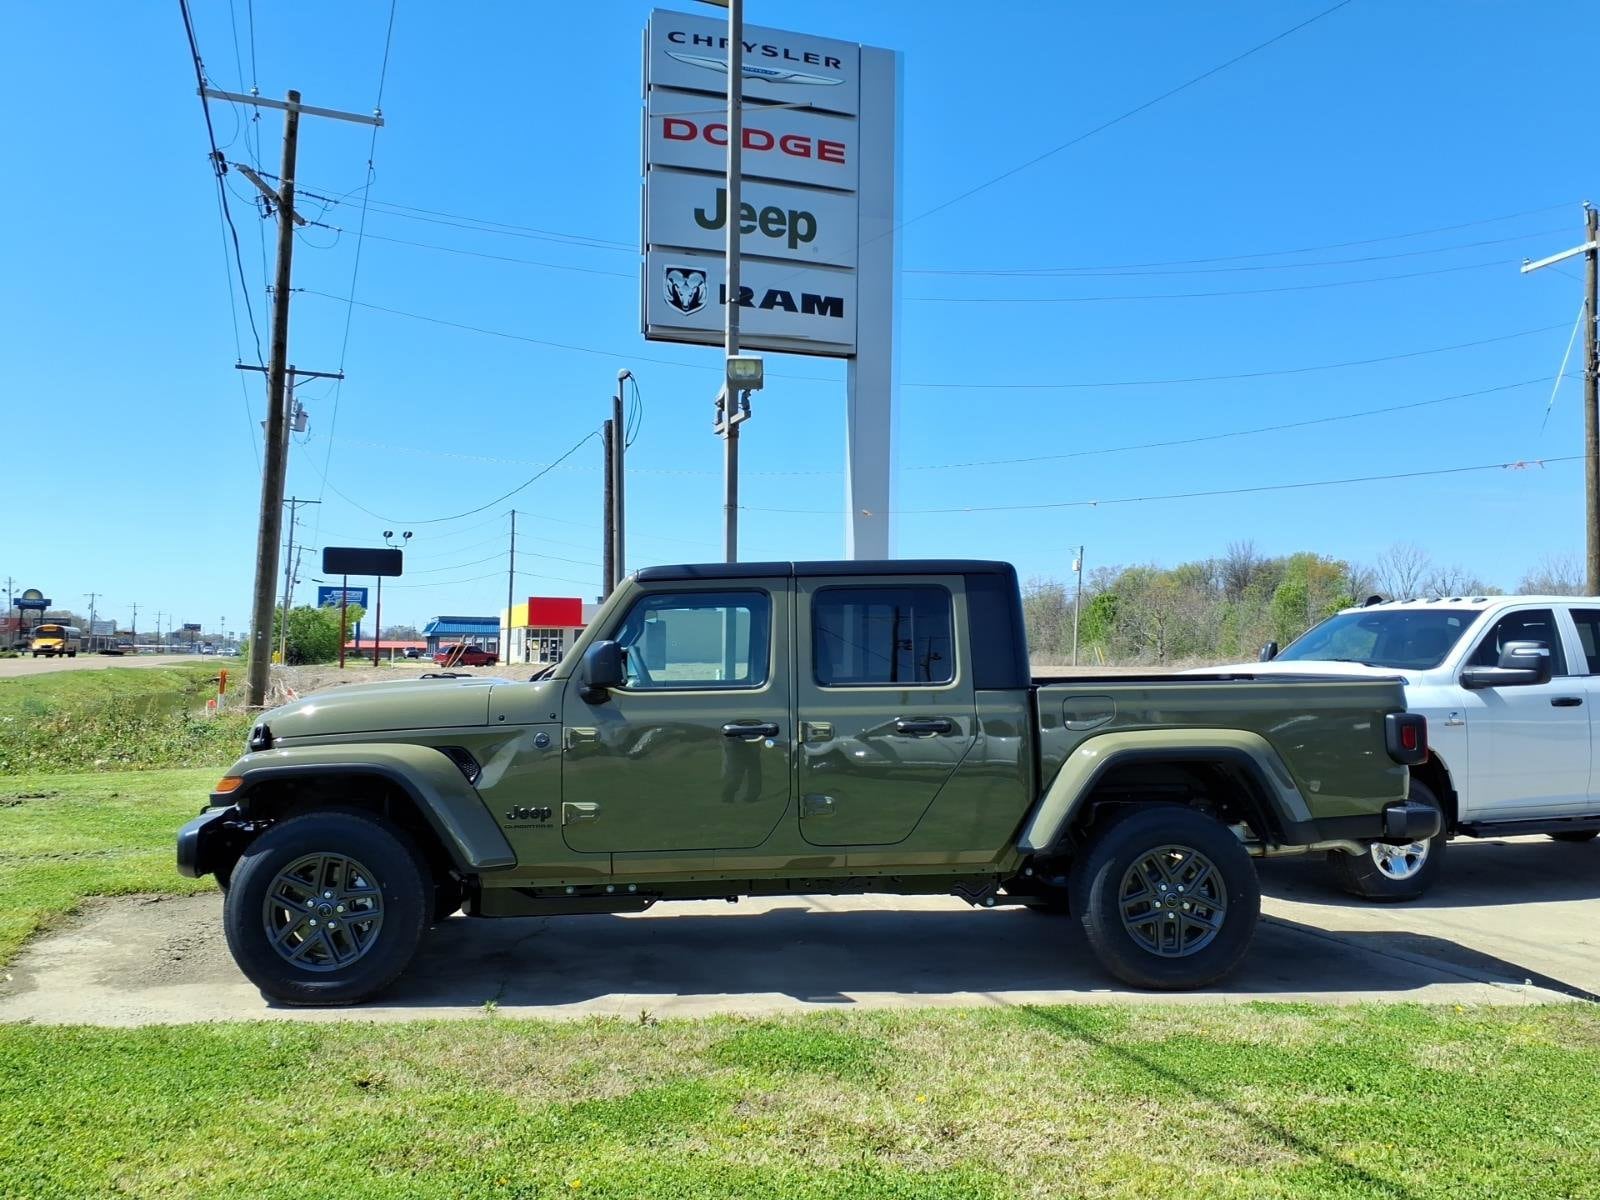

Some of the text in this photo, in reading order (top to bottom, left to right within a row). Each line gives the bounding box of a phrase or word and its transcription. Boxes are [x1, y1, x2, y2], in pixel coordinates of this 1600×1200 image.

[663, 117, 846, 165] DODGE
[694, 187, 817, 250] Jeep
[719, 283, 844, 318] RAM
[505, 804, 552, 823] Jeep
